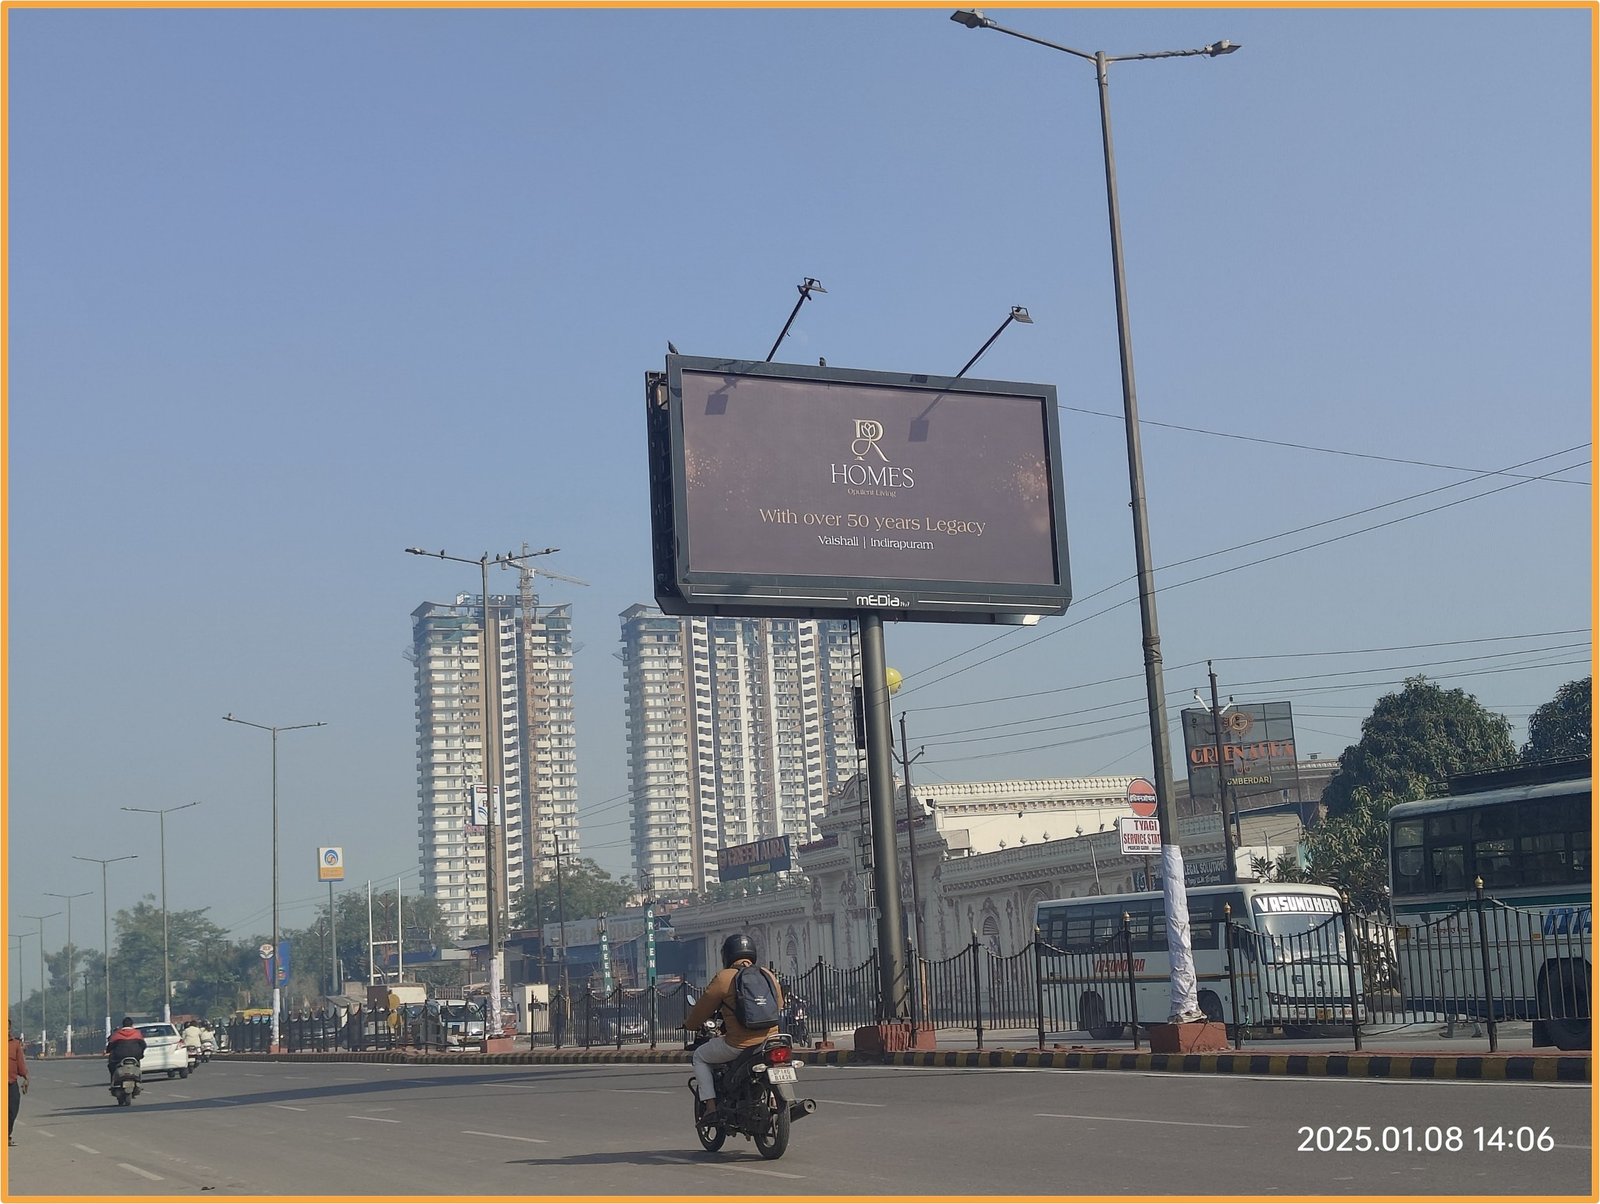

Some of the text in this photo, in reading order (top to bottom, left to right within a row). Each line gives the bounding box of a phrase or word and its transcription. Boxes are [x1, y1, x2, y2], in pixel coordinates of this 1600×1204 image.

[830, 463, 915, 489] HOMES
[875, 489, 897, 498] Living
[759, 508, 987, 537] With over 50 years Legacy
[870, 537, 935, 551] Indirapuram
[1133, 820, 1158, 831] TYAGI
[1123, 833, 1161, 845] SERVICE STAT
[1255, 896, 1343, 912] VASUNDHAR
[646, 910, 656, 968] GREEN
[601, 935, 611, 977] GREEN
